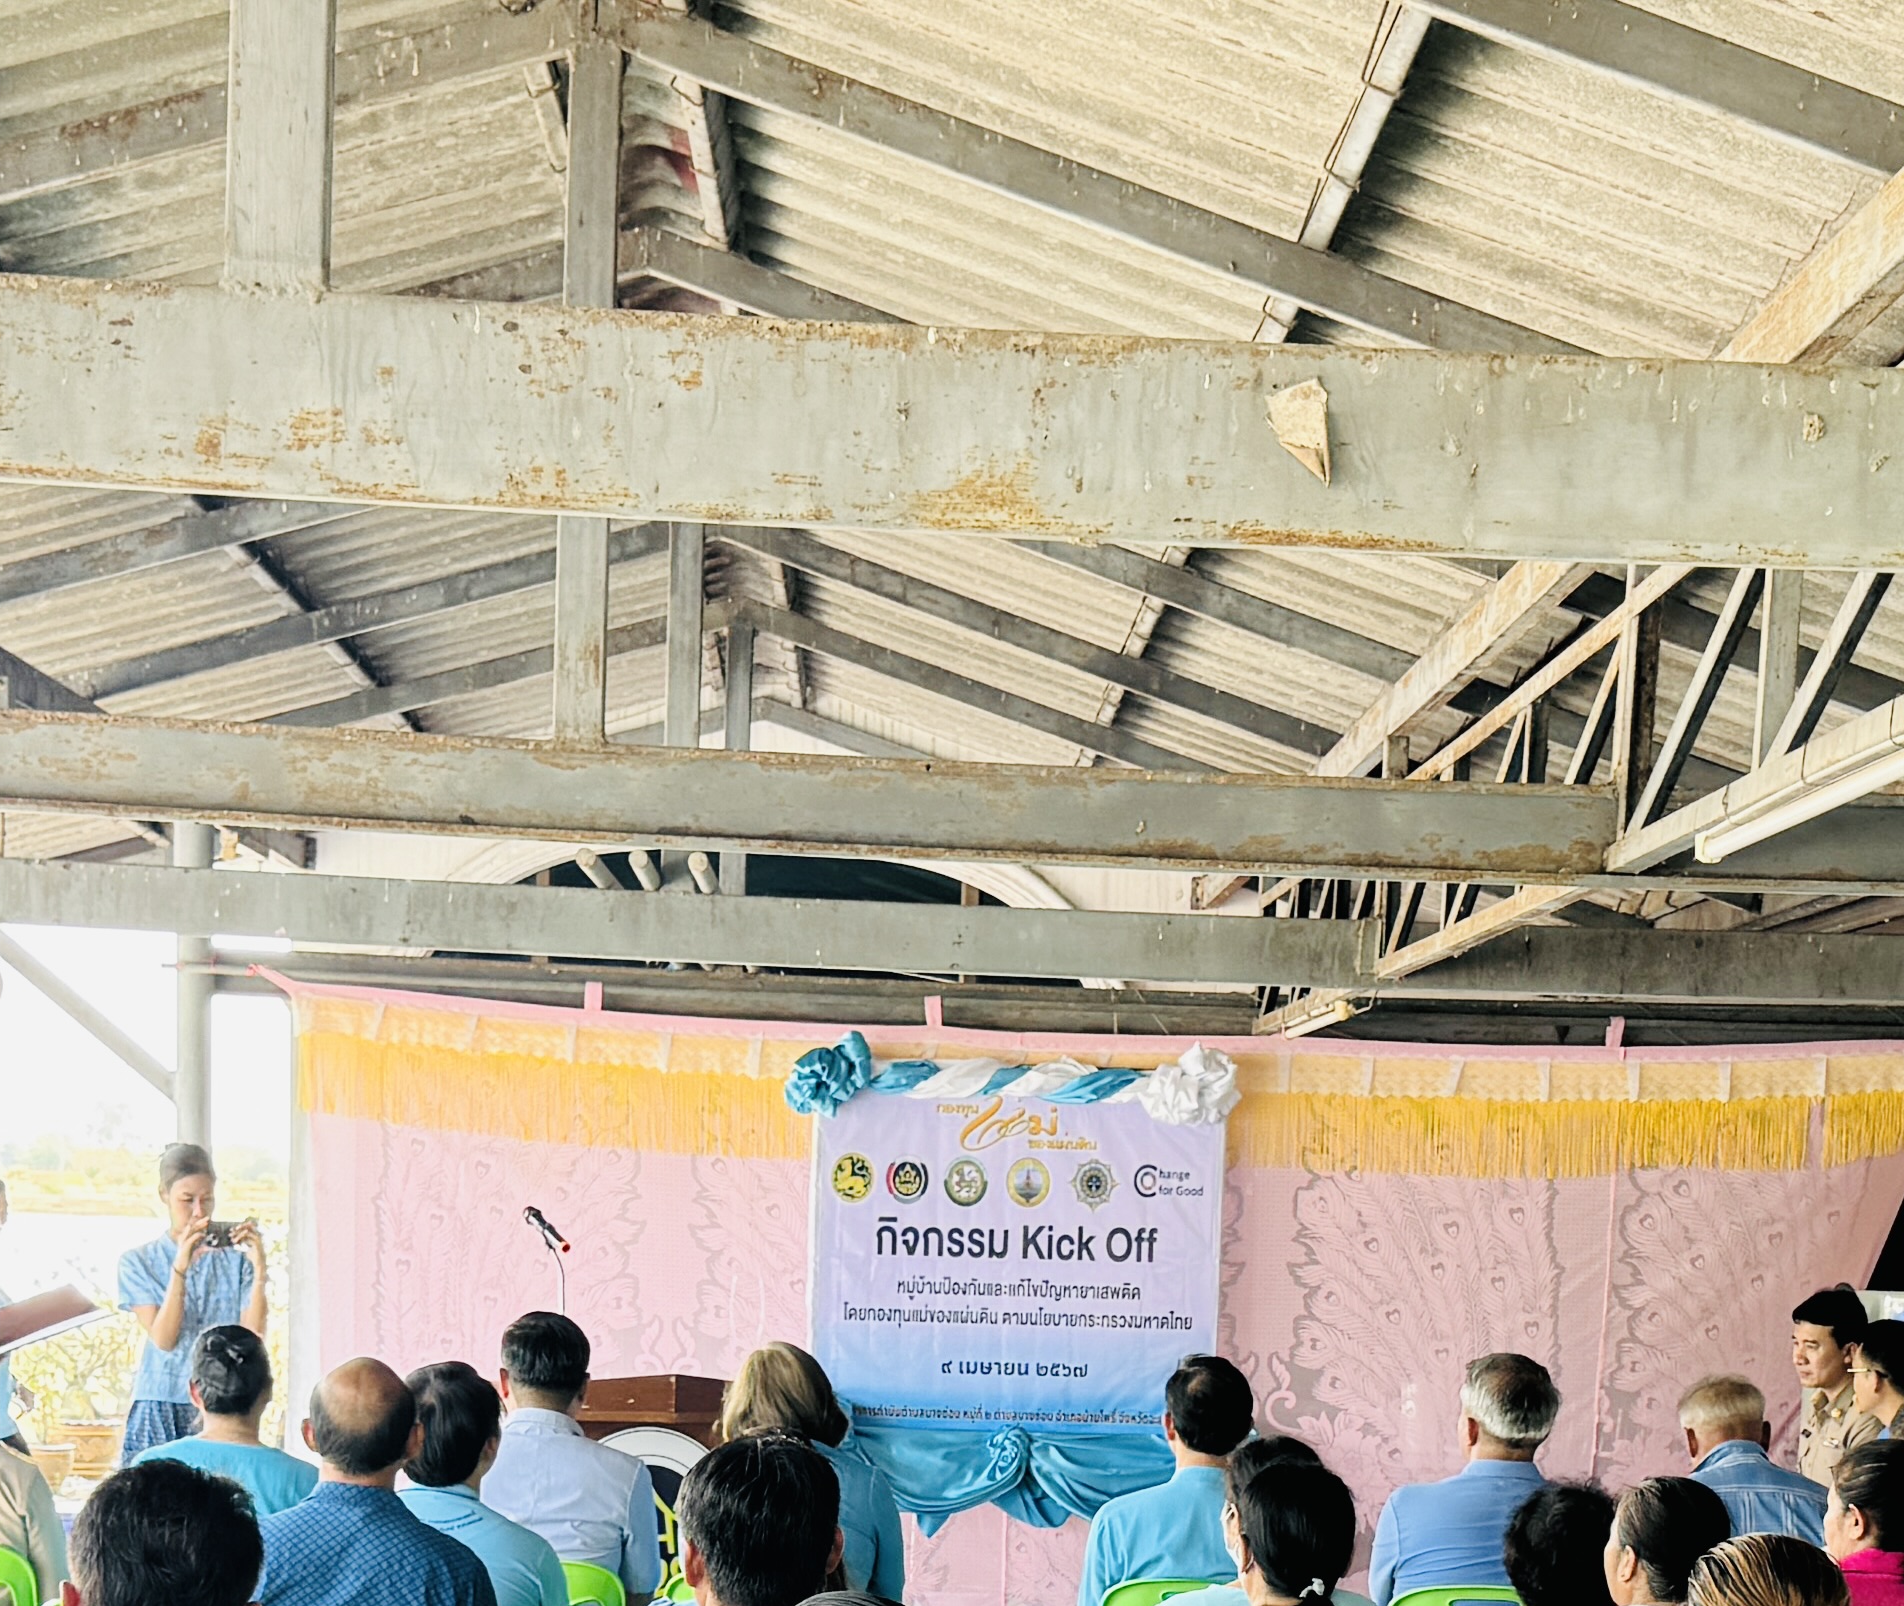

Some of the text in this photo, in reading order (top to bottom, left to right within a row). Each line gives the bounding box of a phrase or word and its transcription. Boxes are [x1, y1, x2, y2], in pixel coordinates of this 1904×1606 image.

[1159, 1185, 1204, 1198] for Good
[876, 1216, 1159, 1263] กิจกรรม Kick Off
[896, 1274, 1141, 1302] หมู่บ้านป้องกันและแก้ไขปัญหายาเสพติด
[843, 1300, 1193, 1332] โดยกองทุนแม่ของแผ่นดิน ตามนโยบายกระทรวงมหาดไทย
[958, 1361, 1029, 1377] เมษายน
[1035, 1361, 1089, 1379] ๒๕๖๗
